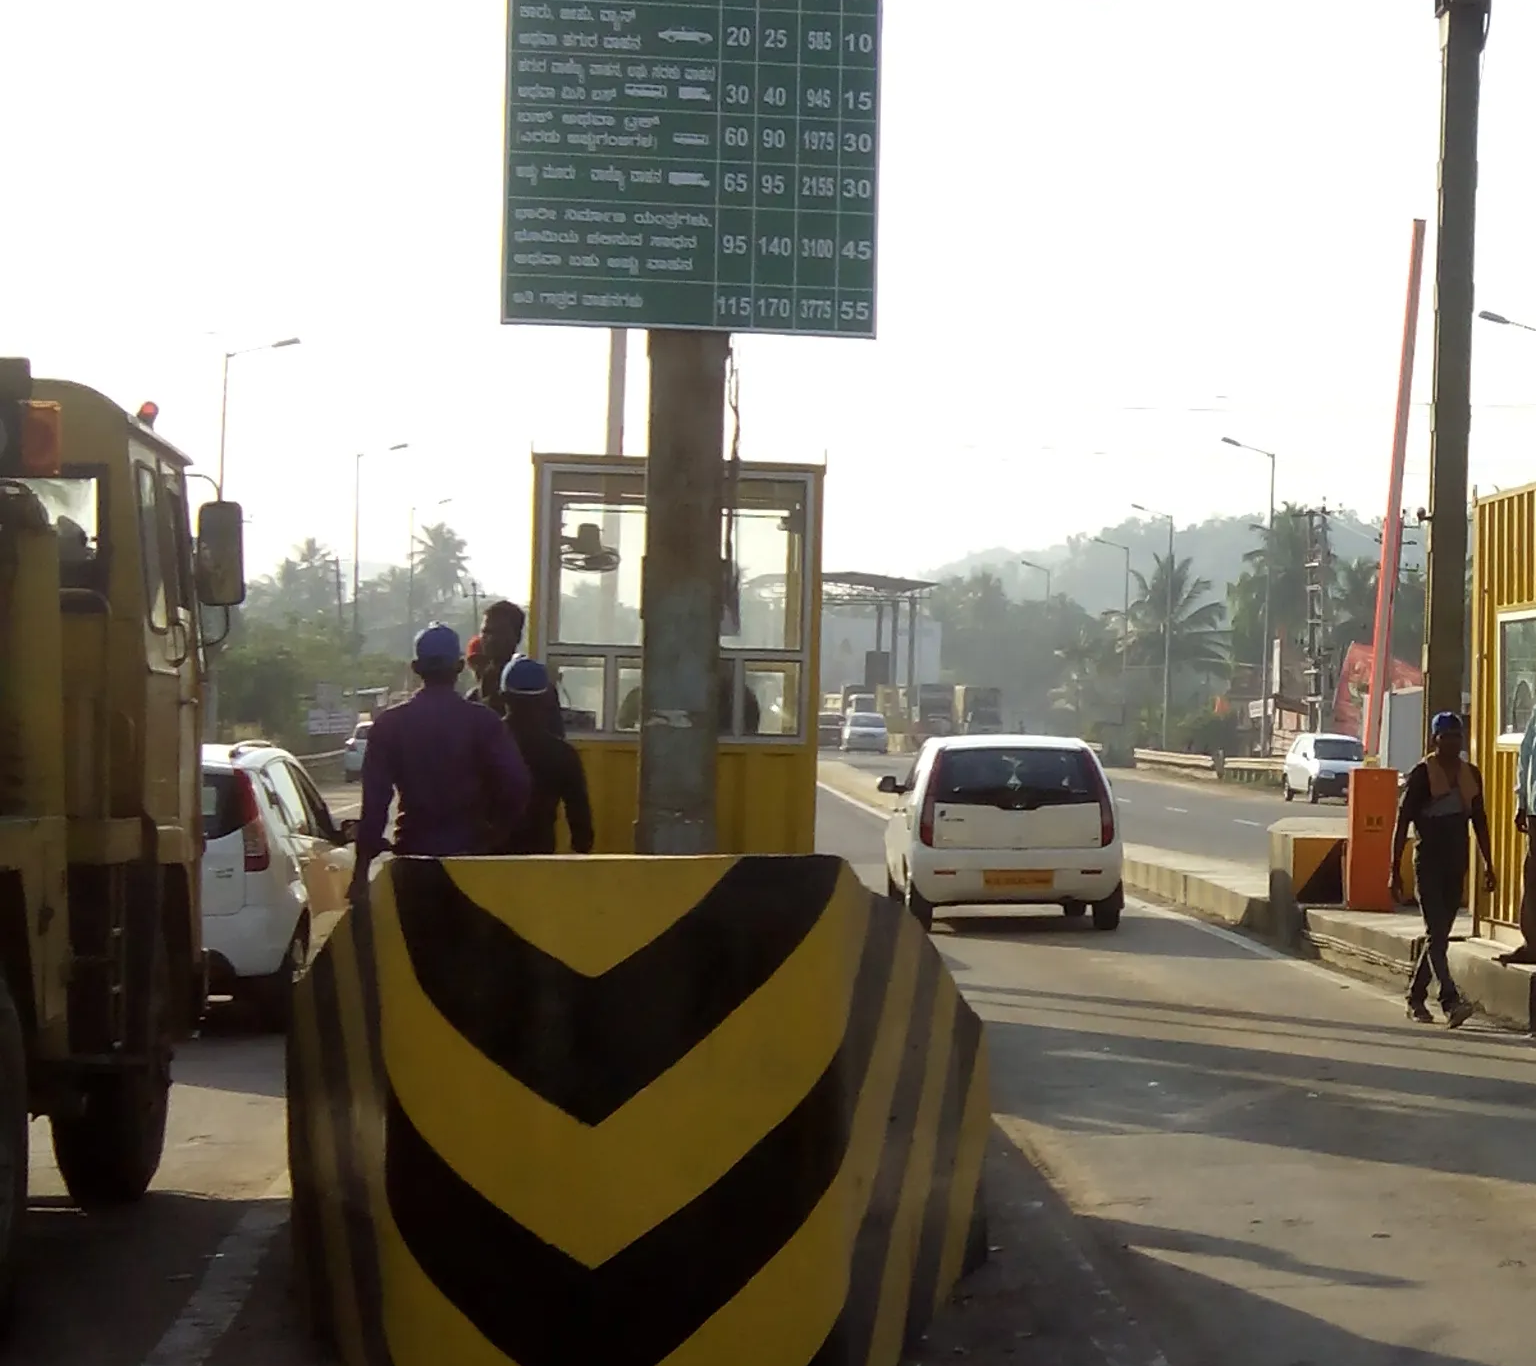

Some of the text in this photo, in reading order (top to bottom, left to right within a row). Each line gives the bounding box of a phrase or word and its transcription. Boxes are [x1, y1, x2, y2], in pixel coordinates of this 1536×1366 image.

[727, 27, 872, 53] 20 25 585 10
[726, 84, 872, 110] 30 40 945 15
[725, 128, 872, 153] 60 90 1975 30
[724, 174, 871, 198] 65 95 2155 30
[723, 236, 872, 260] 95 140 3100 45
[718, 297, 869, 320] 115 170 3775 55
